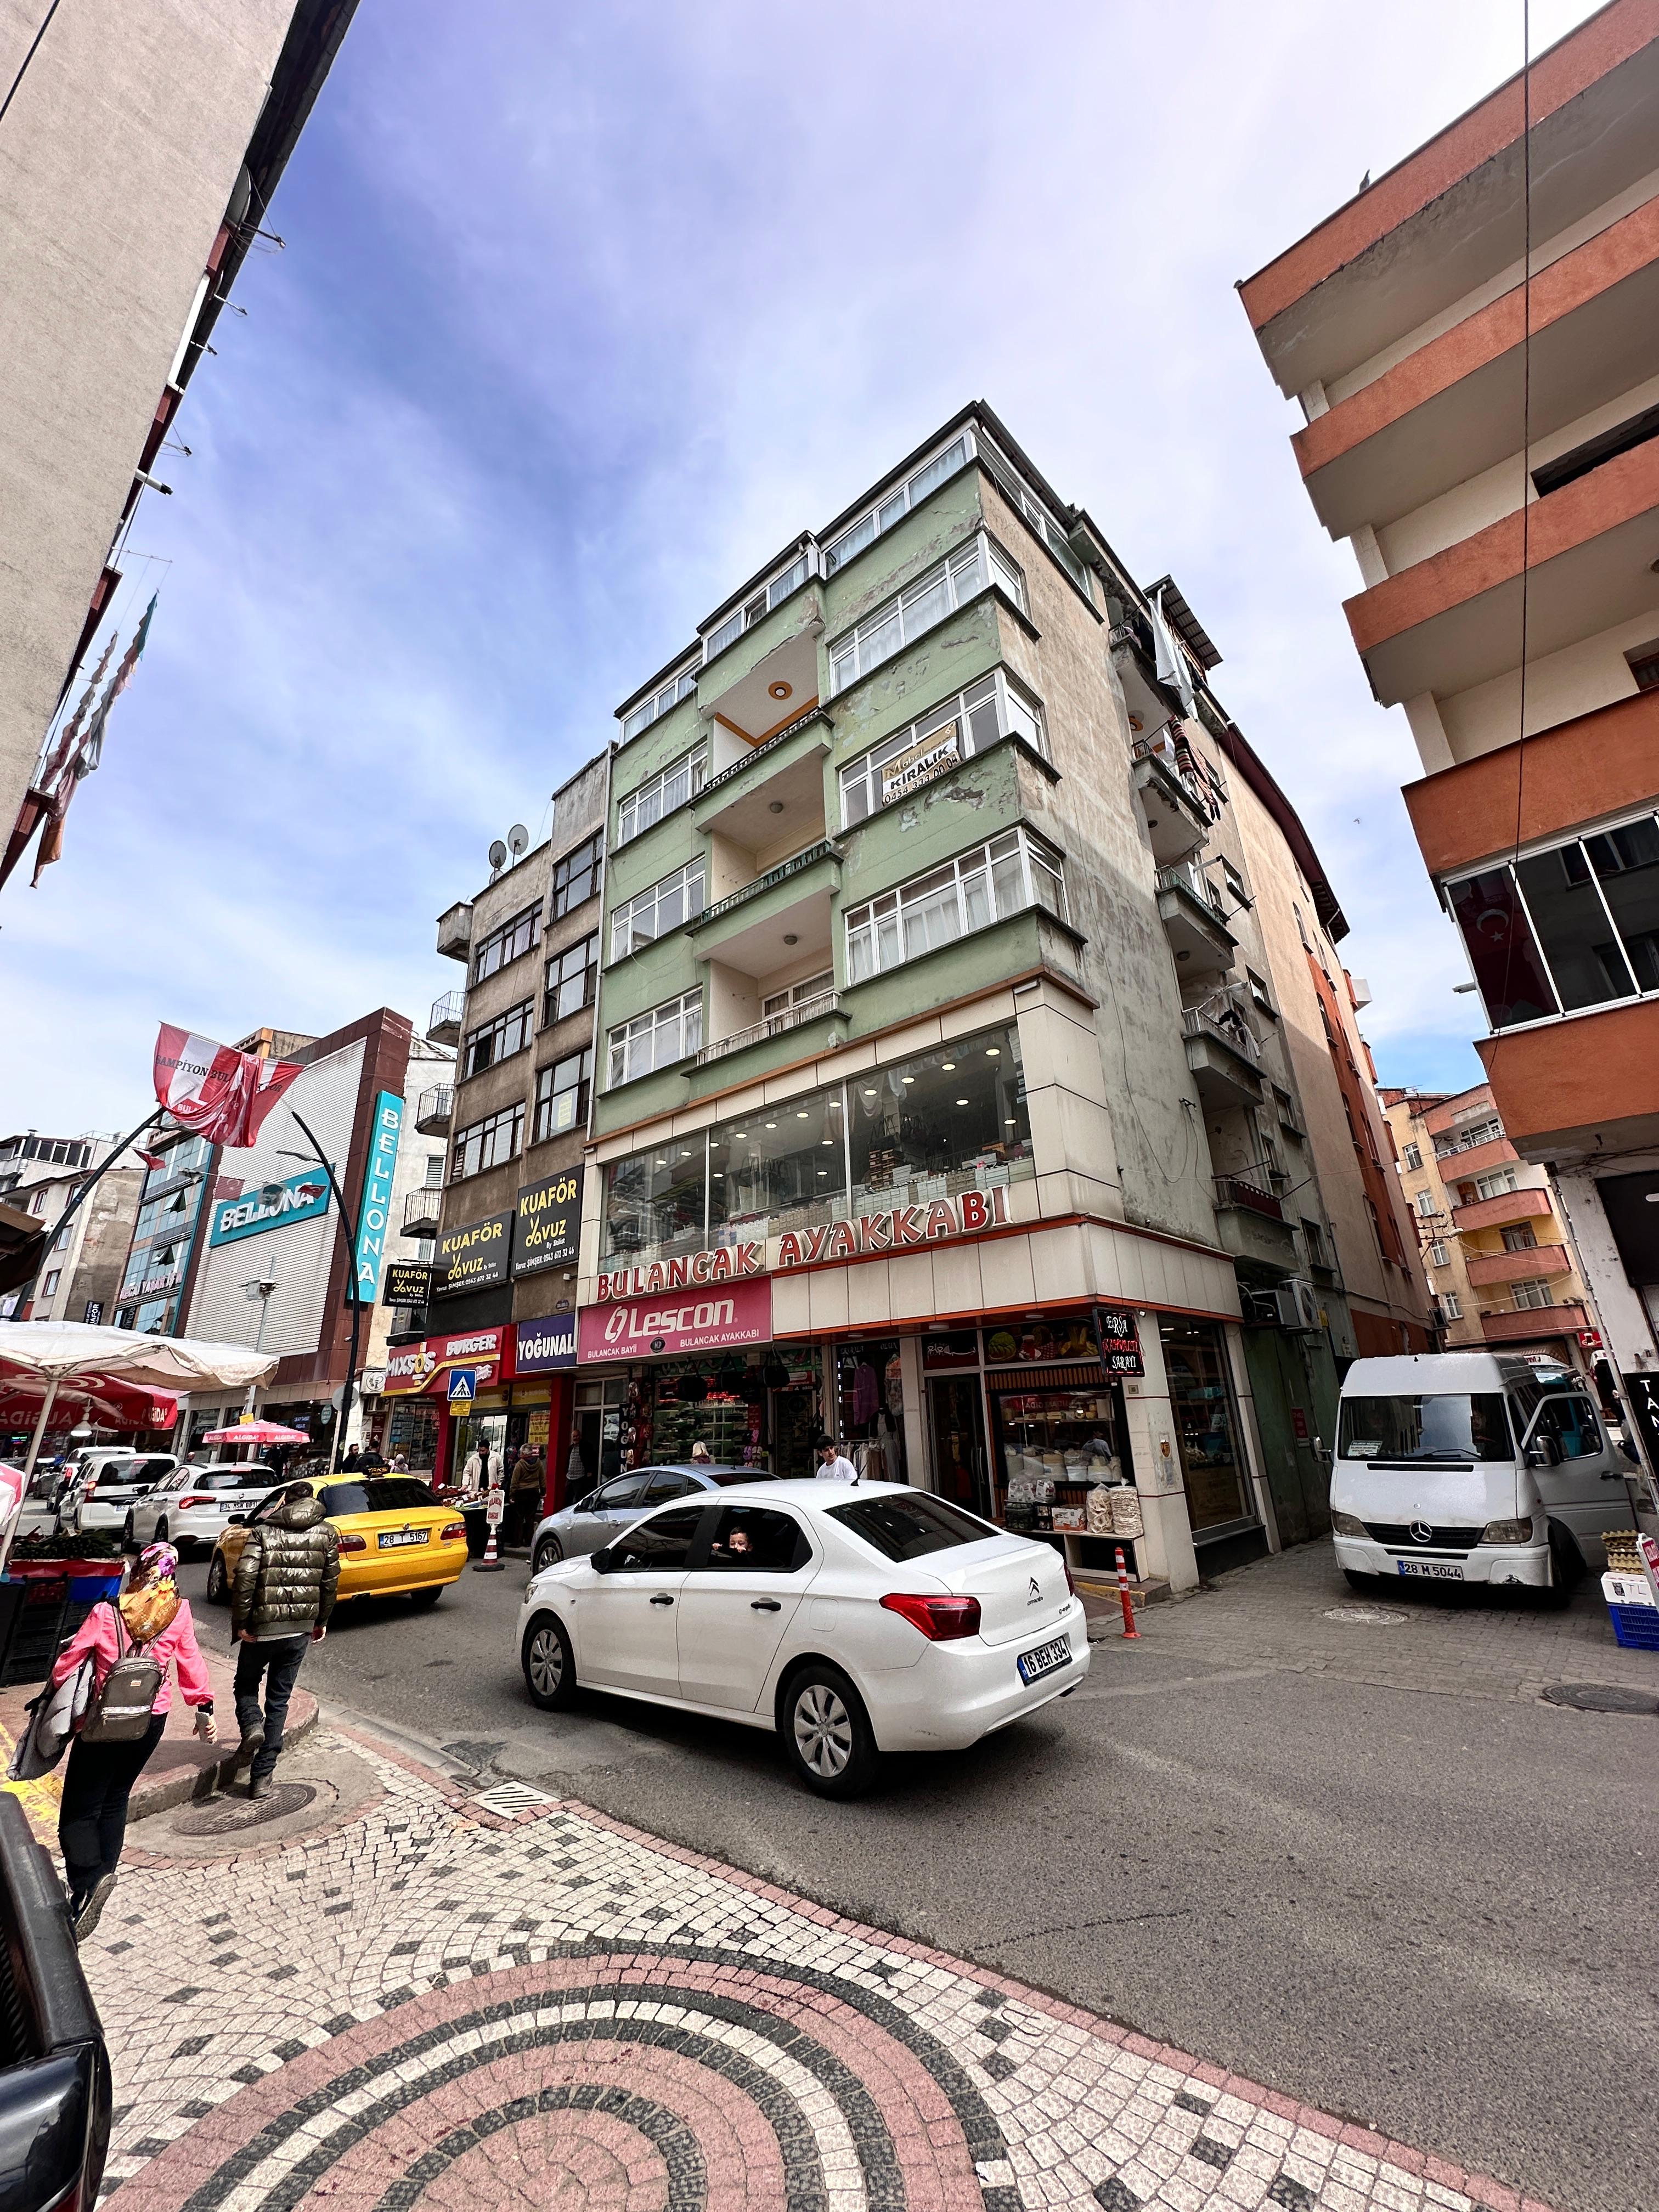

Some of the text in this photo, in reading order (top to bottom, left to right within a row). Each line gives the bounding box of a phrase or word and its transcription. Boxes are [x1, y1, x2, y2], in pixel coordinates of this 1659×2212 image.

[884, 786, 908, 804] 0454
[933, 764, 945, 777] 00
[946, 754, 958, 769] 04
[890, 744, 949, 789] KİRALIK
[358, 1108, 399, 1285] BELLONA
[520, 1176, 577, 1217] KUAFÖR
[442, 1221, 503, 1255] KUAFÖR
[596, 1183, 1010, 1304] BULANCAK AYAKKABI
[392, 1269, 427, 1280] KUAFÖR
[446, 1334, 497, 1357] BURGER
[518, 1332, 574, 1361] YOĞUNAL
[588, 1347, 619, 1359] BULANCAK
[680, 1335, 719, 1348] BULANCAK
[721, 1329, 760, 1342] AYAKKABI
[1112, 1356, 1137, 1371] SARAYI
[384, 1531, 427, 1545] 28 T 5167
[1404, 1563, 1461, 1578] 28 M 5044
[1023, 1655, 1037, 1675] 16
[1034, 1647, 1054, 1669] BEH
[1051, 1639, 1068, 1662] 334
